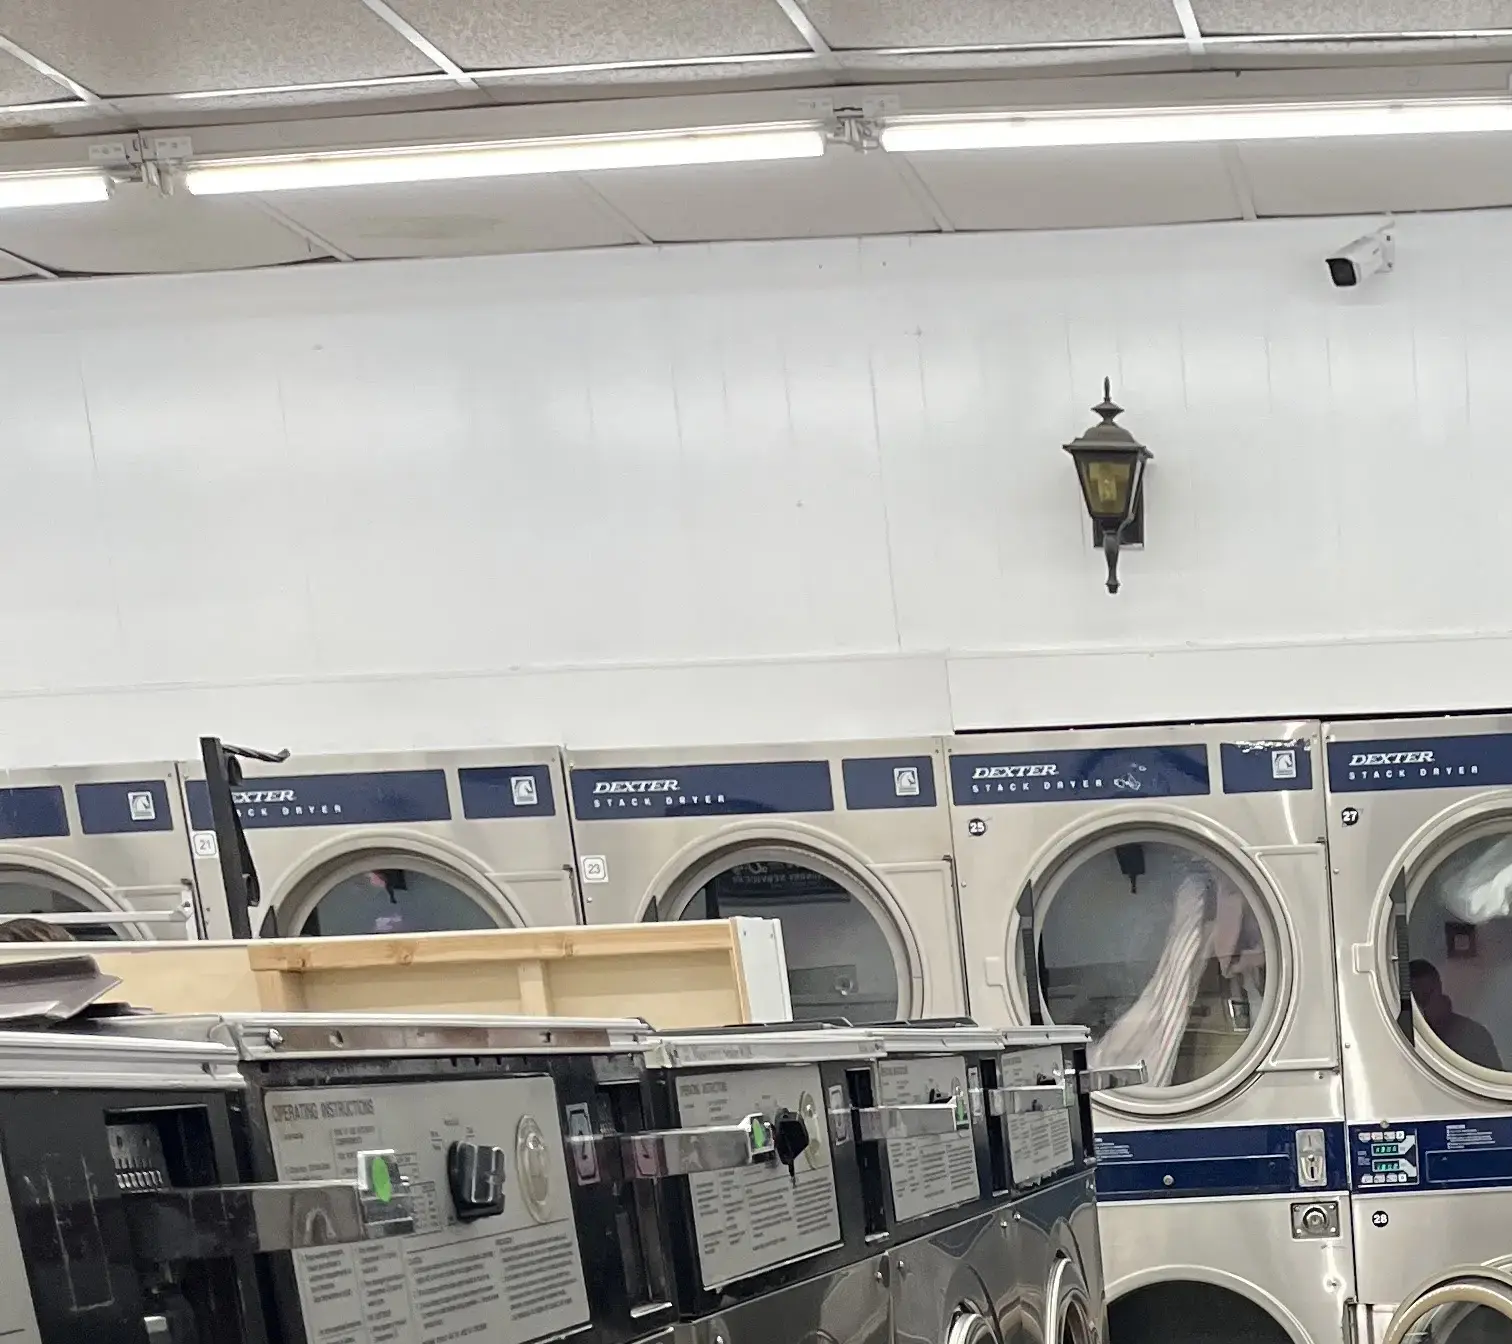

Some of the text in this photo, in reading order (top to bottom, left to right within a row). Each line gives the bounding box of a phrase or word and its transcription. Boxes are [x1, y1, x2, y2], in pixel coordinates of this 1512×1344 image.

[1349, 750, 1435, 766] DEXTER
[972, 764, 1059, 779] DEXTER
[1349, 765, 1479, 780] STACK DRYER
[593, 779, 680, 794] DEXTER
[972, 779, 1103, 793] STACK DRYER
[231, 789, 297, 804] EXTER
[593, 794, 725, 808] STACK DRYER
[281, 804, 342, 816] DRYER
[1342, 811, 1358, 822] 27
[969, 821, 985, 833] 25
[199, 839, 212, 851] 21
[587, 863, 601, 875] 23
[1373, 1213, 1389, 1225] 28
